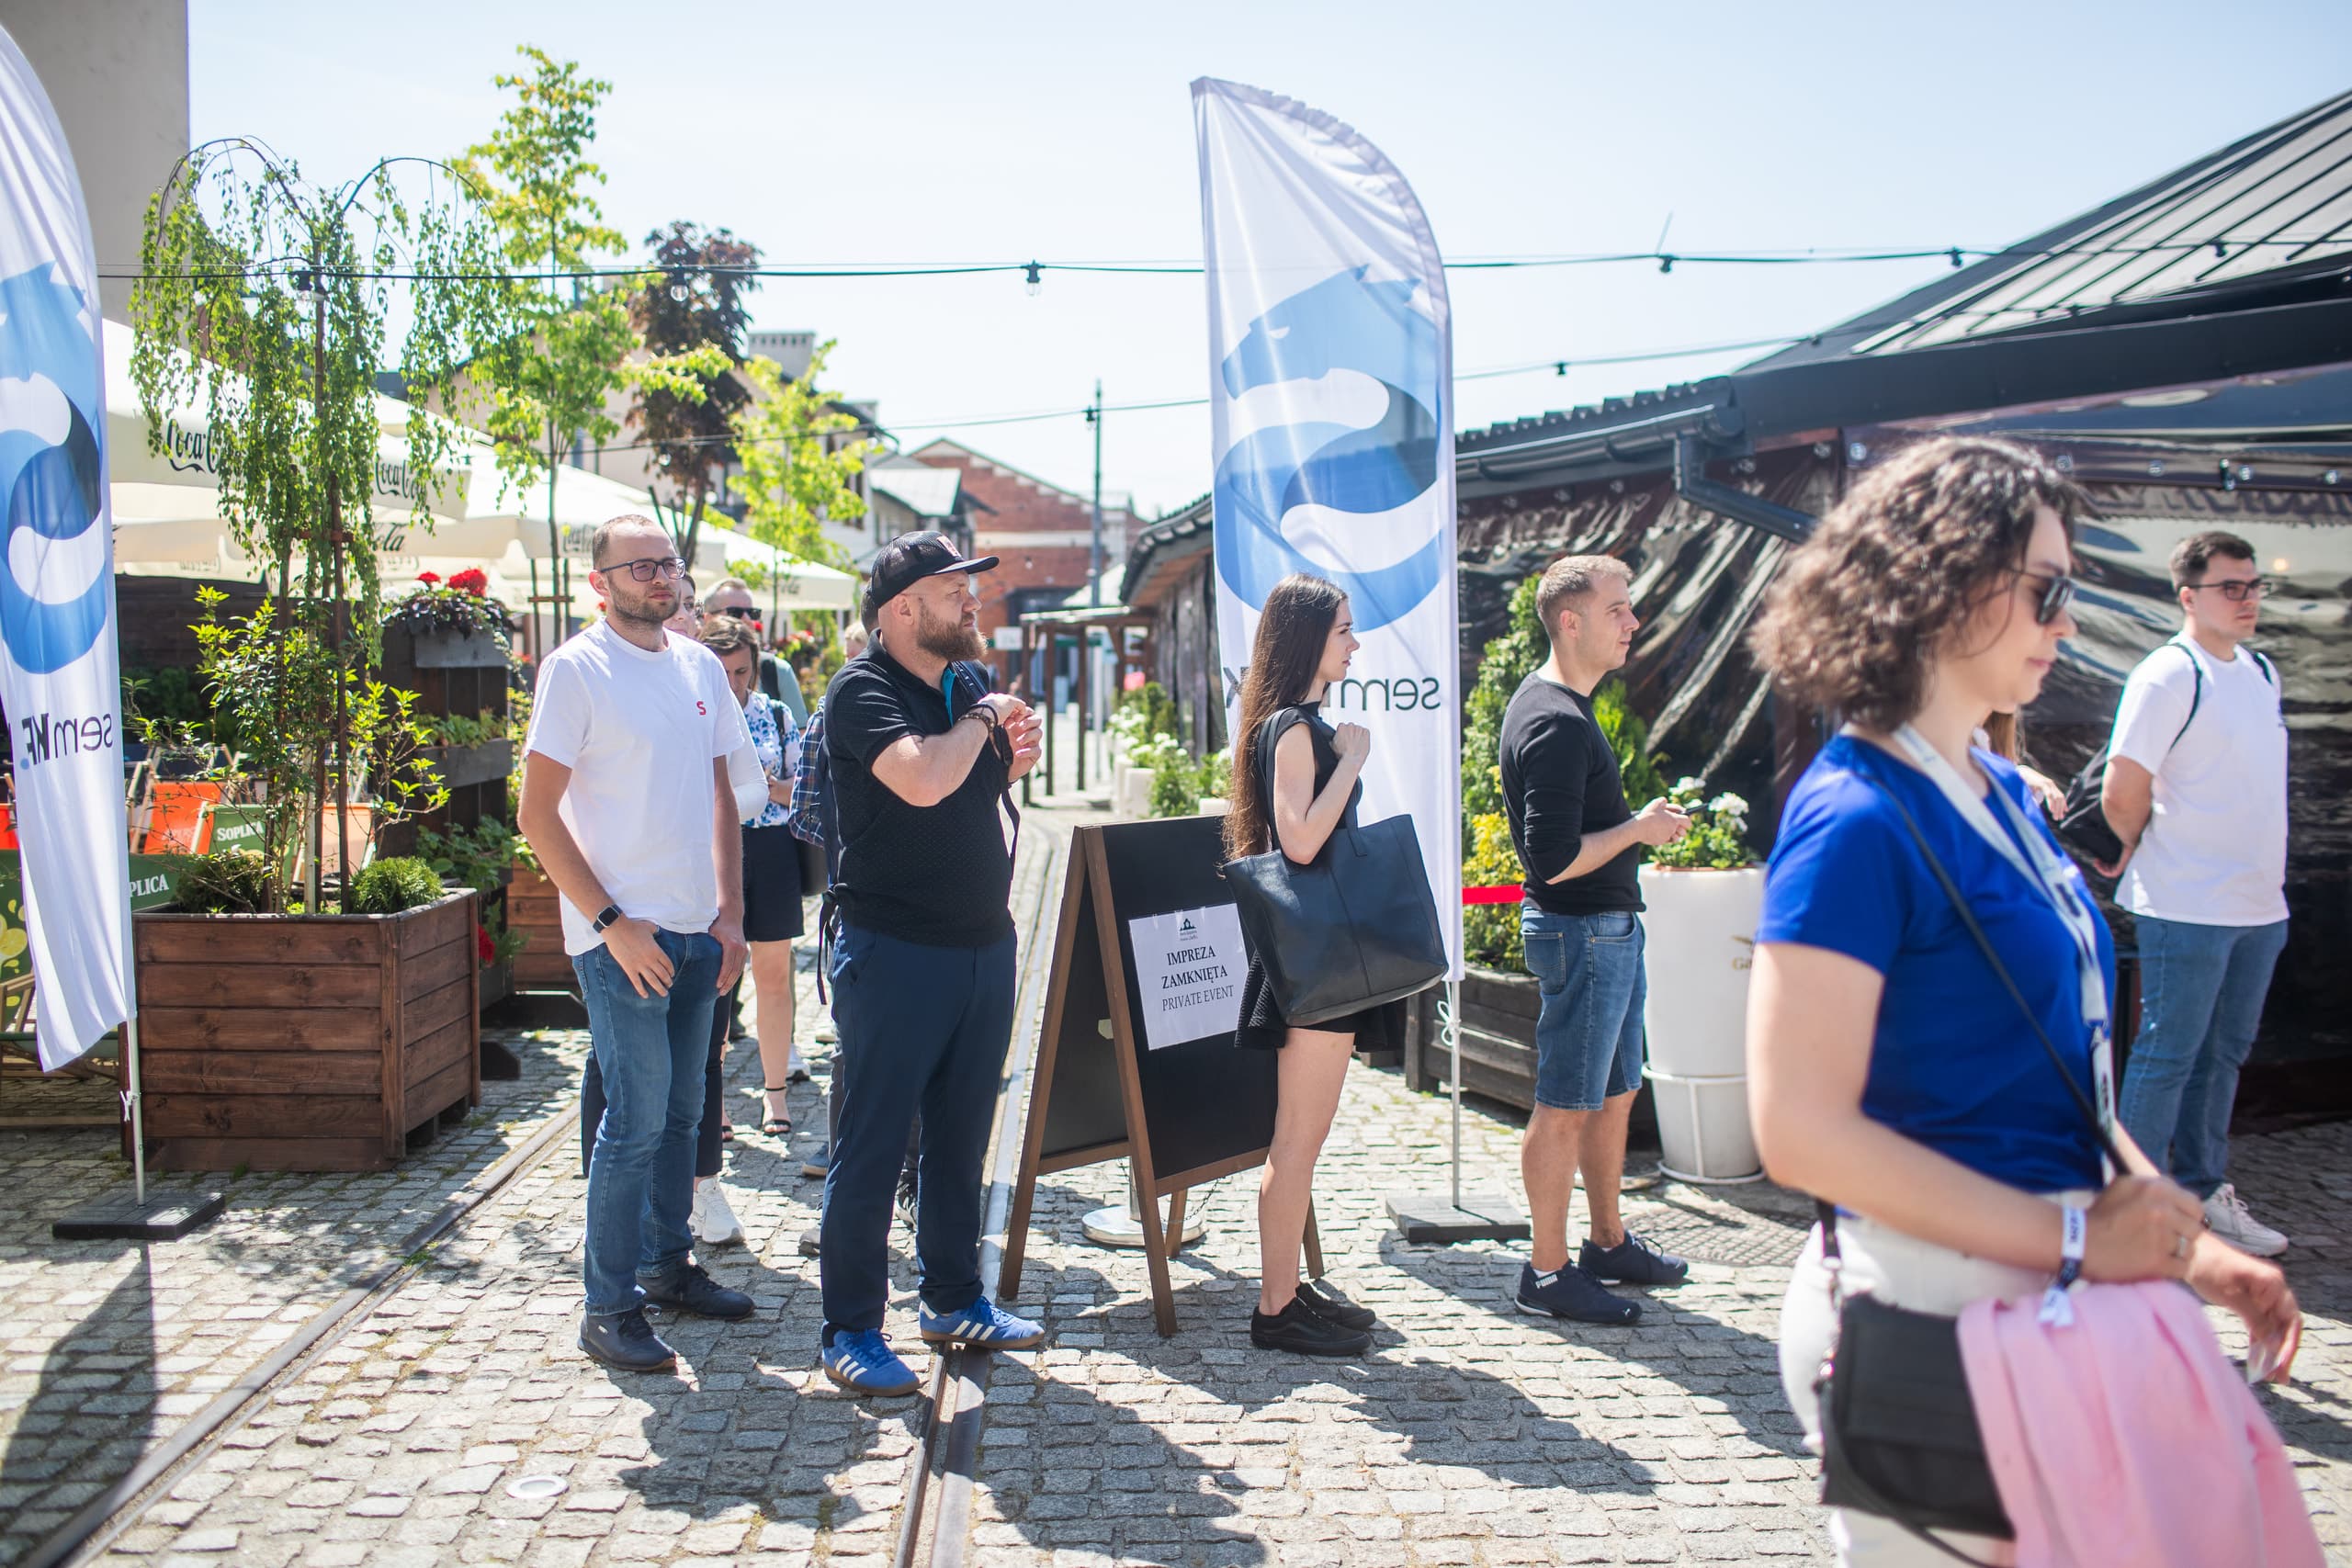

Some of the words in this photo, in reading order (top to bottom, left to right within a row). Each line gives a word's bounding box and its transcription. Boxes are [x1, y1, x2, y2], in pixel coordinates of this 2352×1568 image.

[696, 701, 707, 716] S
[217, 821, 265, 842] SOPLICA
[130, 874, 170, 898] PLICA
[1167, 945, 1216, 965] IMPREZA
[1161, 964, 1228, 989] ZAMKNIĘTA
[1162, 991, 1203, 1011] PRIVATE
[1204, 985, 1234, 1002] EVENT
[1535, 1273, 1558, 1289] PUMA
